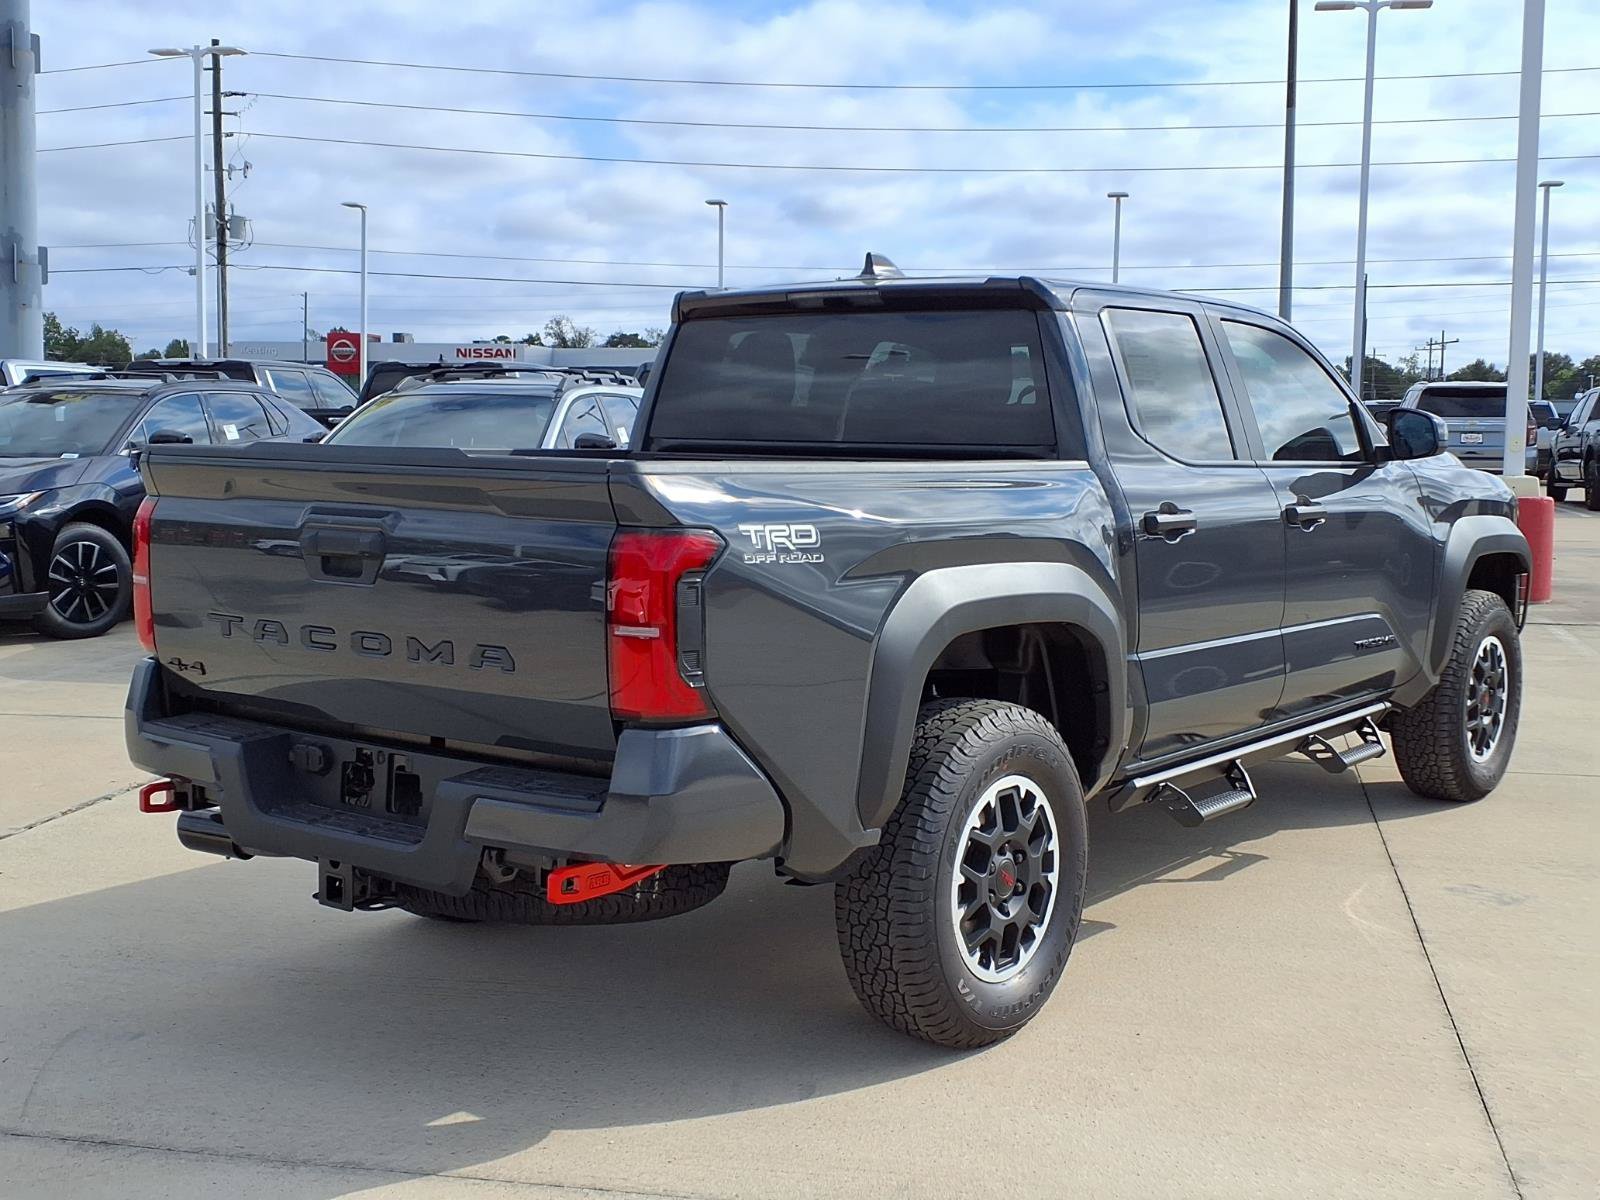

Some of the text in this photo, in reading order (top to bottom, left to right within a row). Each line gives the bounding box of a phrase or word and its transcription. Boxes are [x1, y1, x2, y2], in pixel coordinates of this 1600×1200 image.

[456, 348, 516, 359] NISSAN
[737, 524, 820, 552] TRD
[743, 553, 825, 564] OFF ROAD
[207, 612, 516, 673] TACOMA
